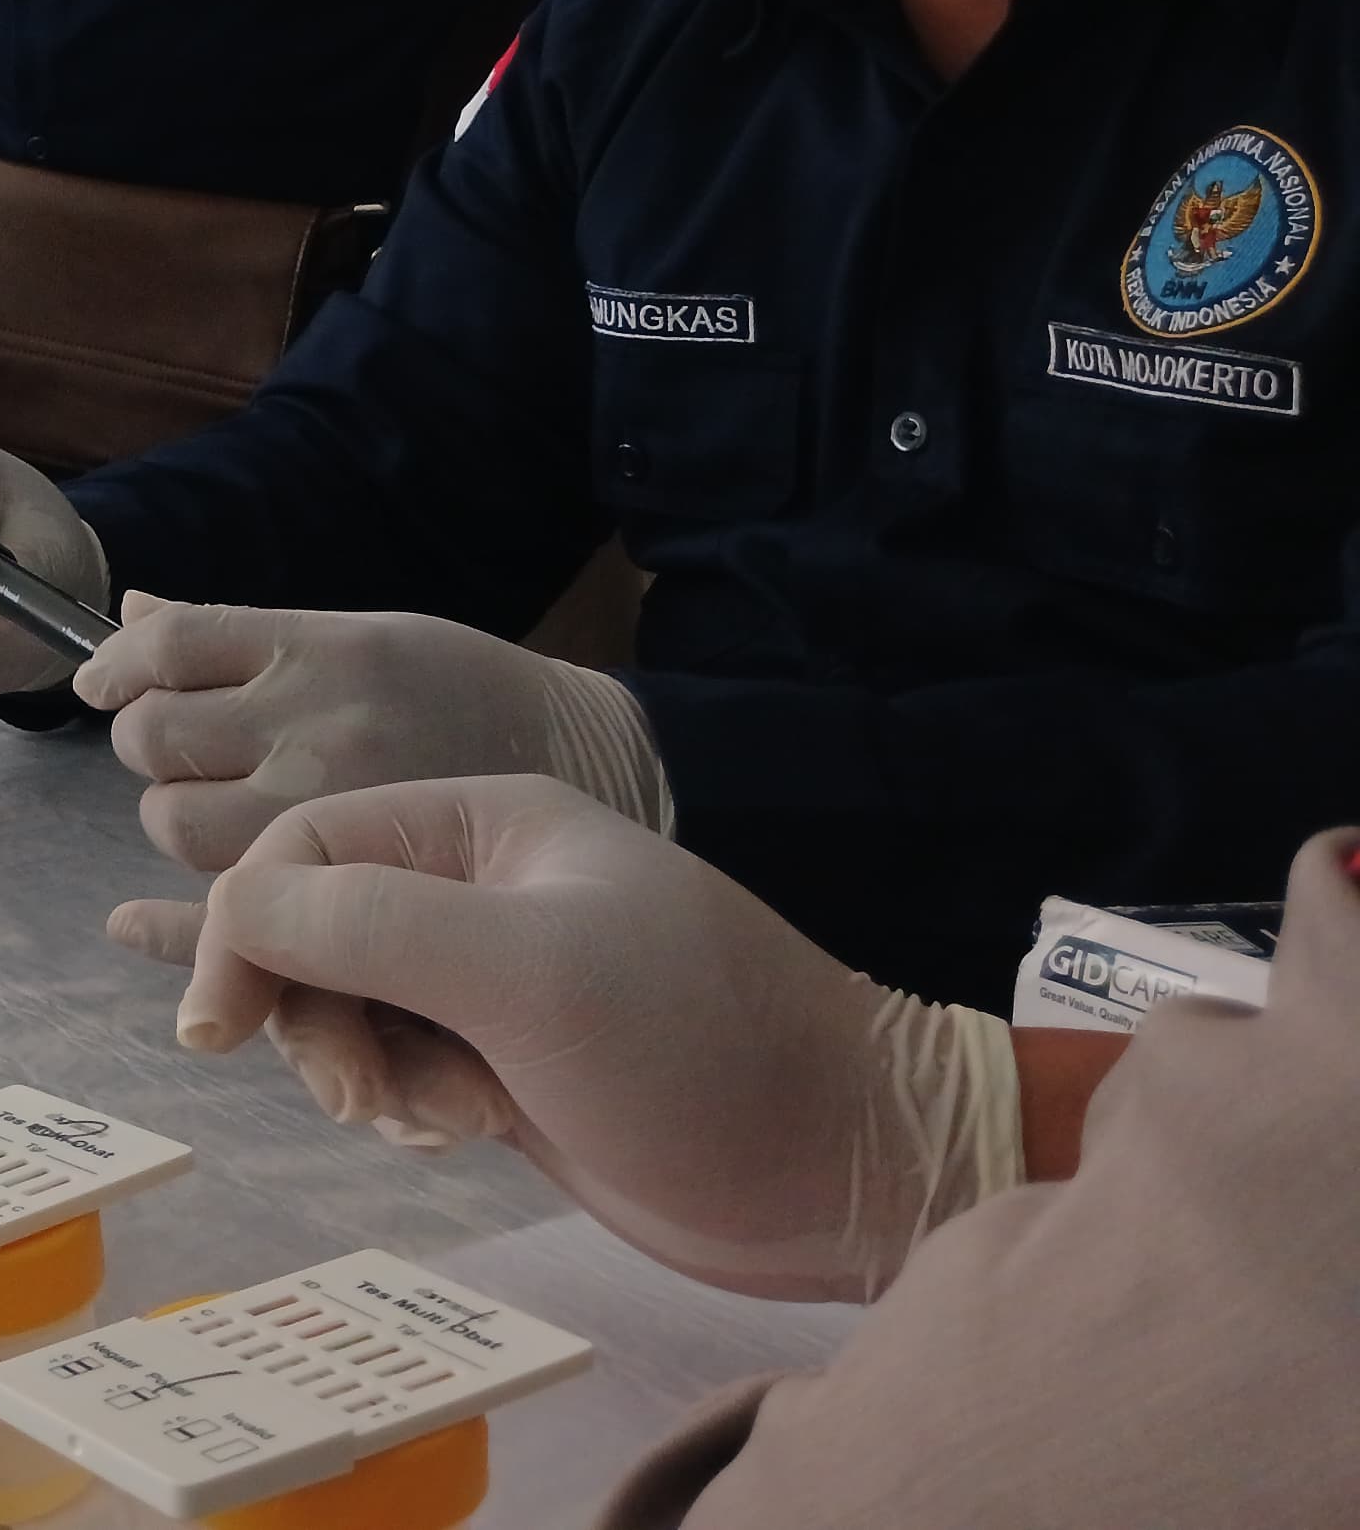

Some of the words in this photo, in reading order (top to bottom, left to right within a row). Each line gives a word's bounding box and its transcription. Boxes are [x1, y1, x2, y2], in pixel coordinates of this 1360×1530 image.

[1263, 150, 1310, 247] NASIONAL
[1168, 276, 1278, 333] INDONESIA
[1066, 337, 1115, 378] KOTA
[1118, 348, 1279, 401] MOJOKERTO
[1039, 986, 1067, 1008] Great
[1068, 995, 1098, 1019] Value,
[1098, 1007, 1134, 1032] Quality
[357, 1280, 392, 1300] Tes
[392, 1298, 449, 1326] Multi
